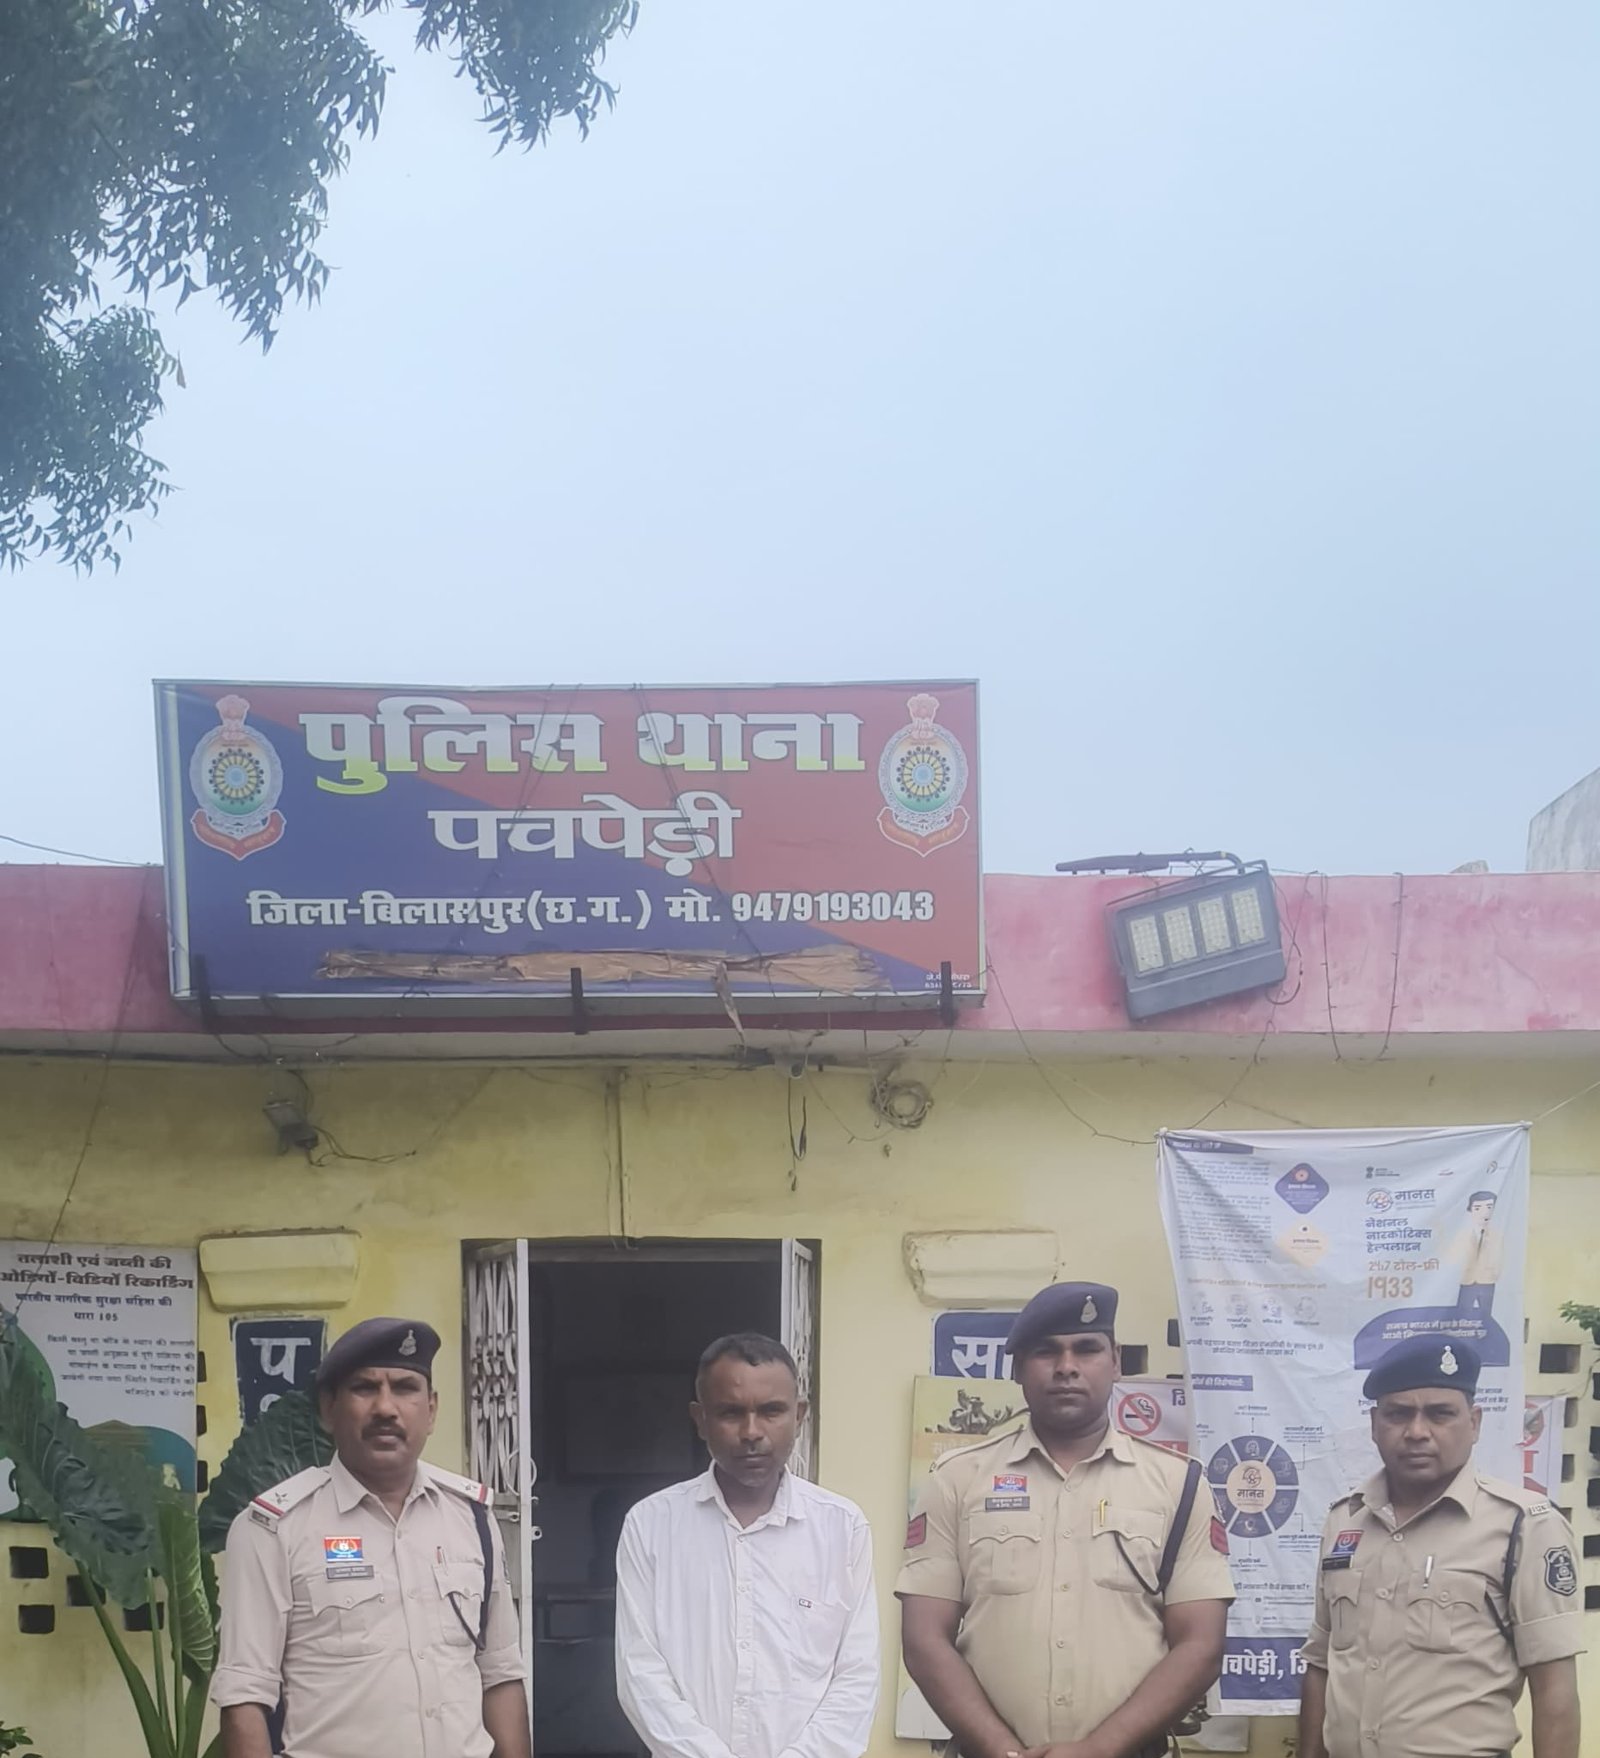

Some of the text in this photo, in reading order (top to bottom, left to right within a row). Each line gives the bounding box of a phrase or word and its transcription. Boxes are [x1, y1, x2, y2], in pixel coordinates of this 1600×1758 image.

[299, 696, 866, 795] पुलिस थाना
[427, 791, 742, 877] पचपेड़ी
[664, 888, 721, 923] मो.
[732, 890, 935, 922] 9479193043
[1395, 1188, 1436, 1201] मानस
[1365, 1217, 1409, 1228] नेशनल
[17, 1253, 72, 1266] तलाशी
[77, 1253, 100, 1268] एवं
[149, 1255, 172, 1269] की
[1367, 1276, 1414, 1299] 1933
[1237, 1488, 1265, 1498] मानस
